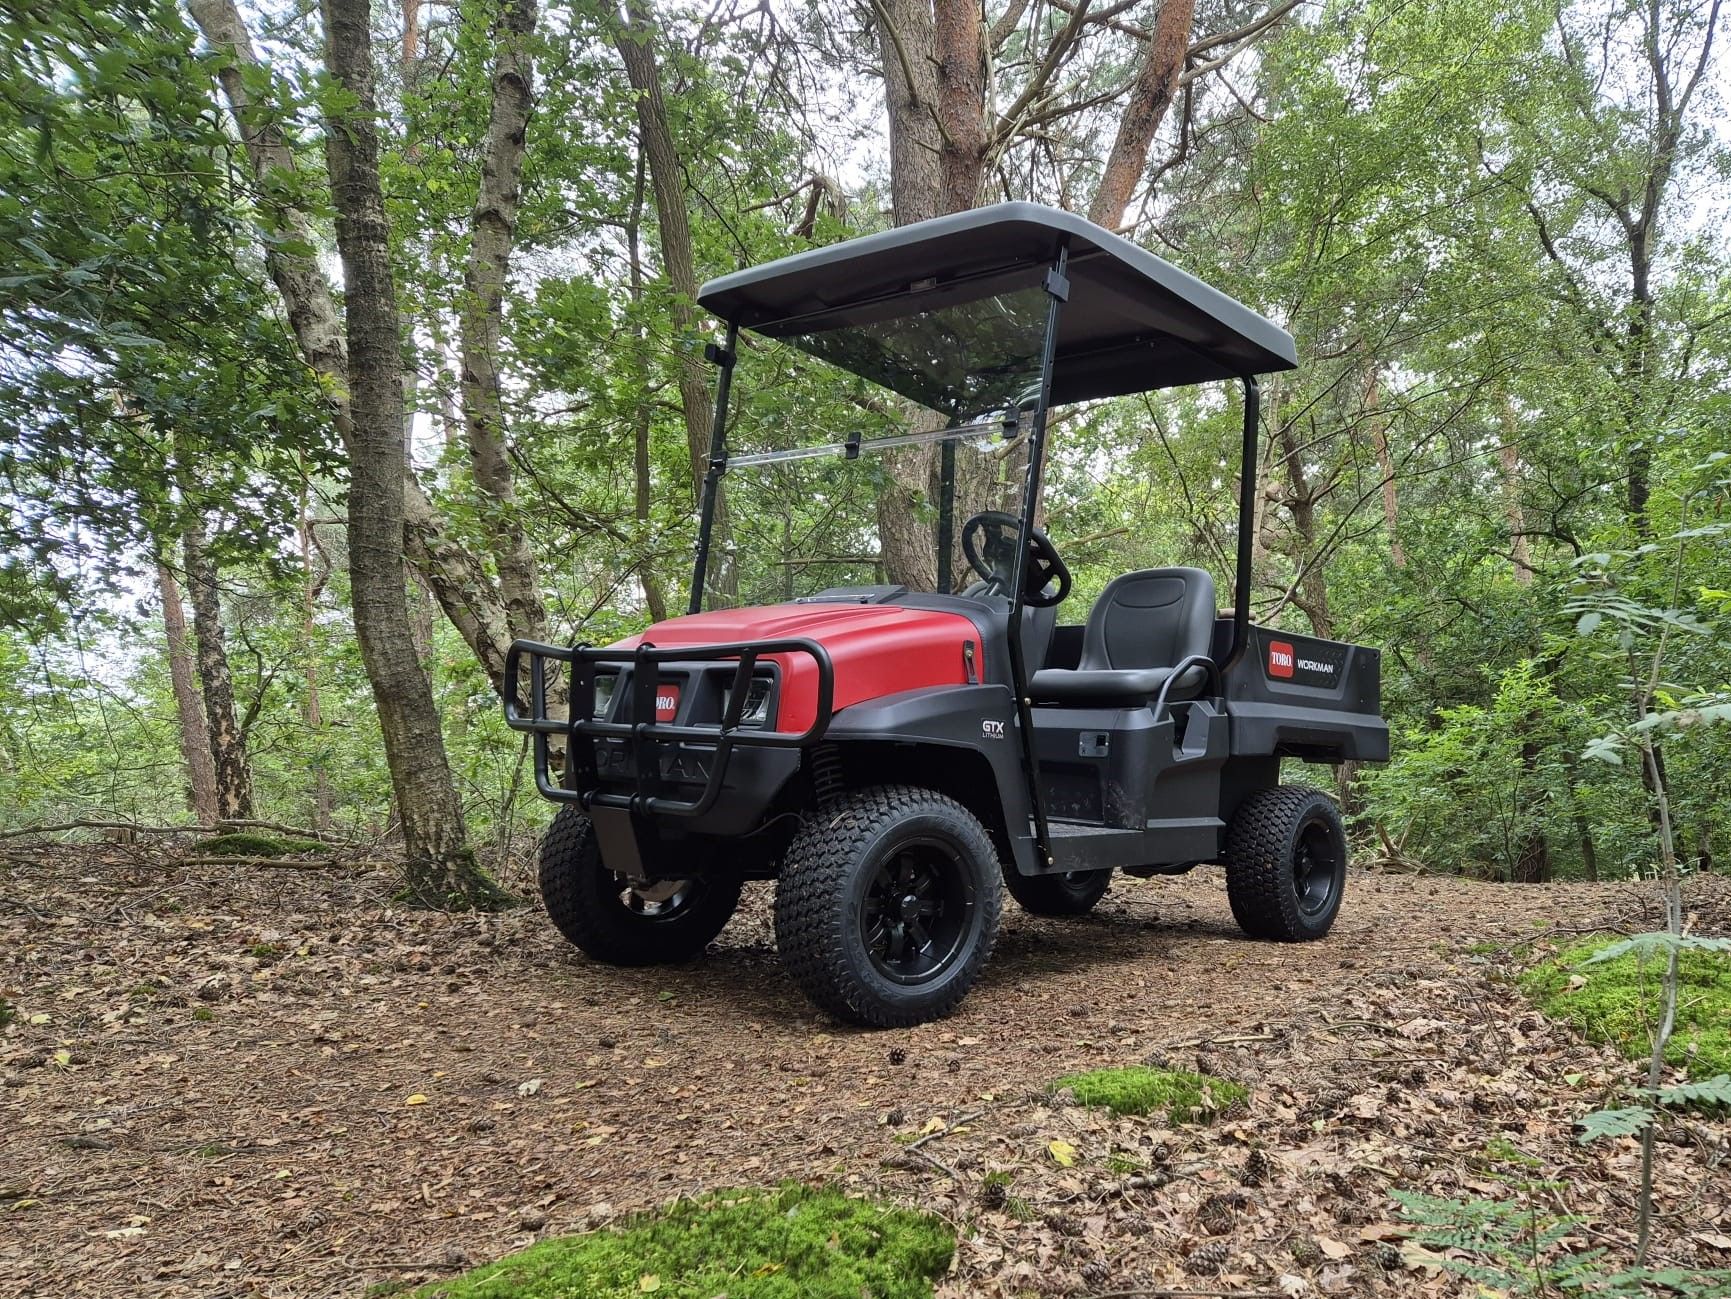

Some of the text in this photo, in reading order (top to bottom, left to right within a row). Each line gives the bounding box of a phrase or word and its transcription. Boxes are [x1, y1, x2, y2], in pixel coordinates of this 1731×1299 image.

[1271, 651, 1334, 674] TORO WORKMAN
[982, 720, 1005, 733] GTX
